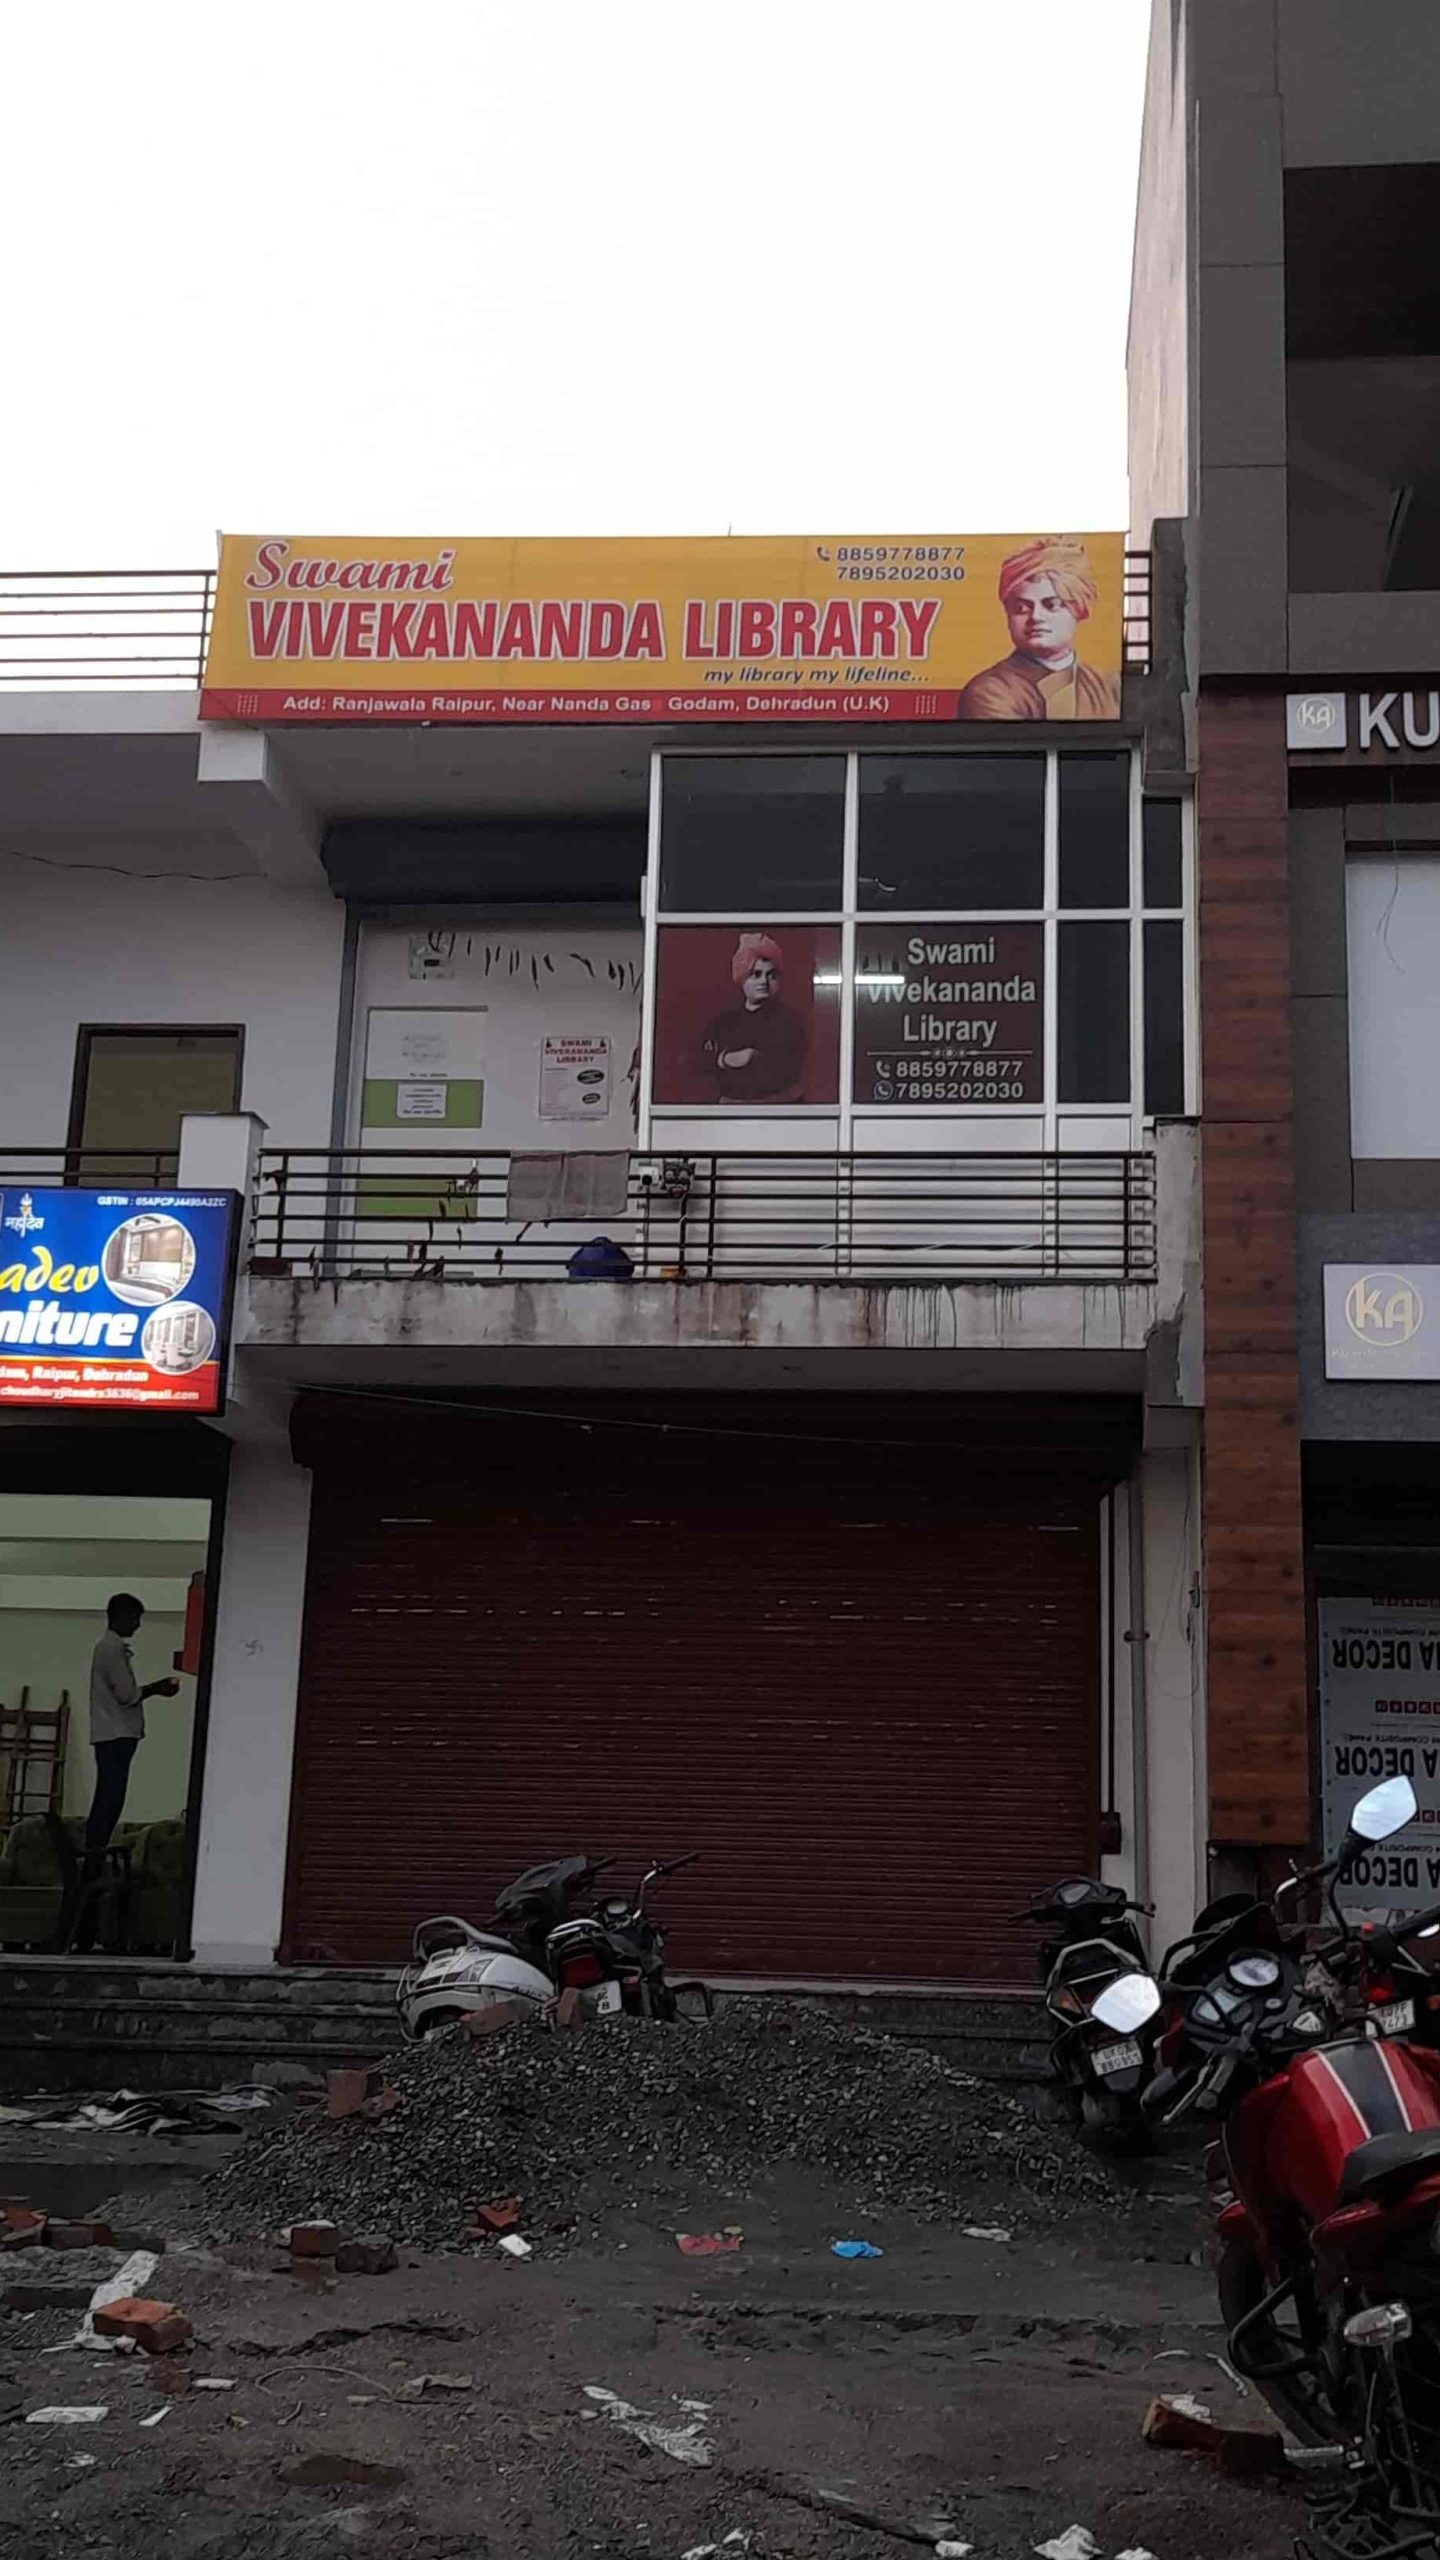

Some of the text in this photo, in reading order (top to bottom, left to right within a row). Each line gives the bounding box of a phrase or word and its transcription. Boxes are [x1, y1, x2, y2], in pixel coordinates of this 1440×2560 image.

[245, 540, 457, 591] Swami
[837, 547, 965, 561] 8859778877
[837, 566, 965, 580] 7895202030
[247, 599, 942, 662] VIVEKANANDA LIBRARY
[704, 666, 930, 684] my library my lifeline...
[283, 696, 889, 714] Add: Ranjawala Raipur, Near Nanda Gas Godam, Dehradun (U.K)
[908, 936, 995, 964] Swami
[868, 975, 1036, 1003] Vivekananda
[903, 1014, 997, 1048] Library
[896, 1061, 1023, 1077] 8859778877
[896, 1083, 1023, 1099] 7895202030
[0, 1300, 139, 1346] niture
[1332, 1639, 1412, 1670] DECOR
[1335, 1746, 1414, 1778] DECOR
